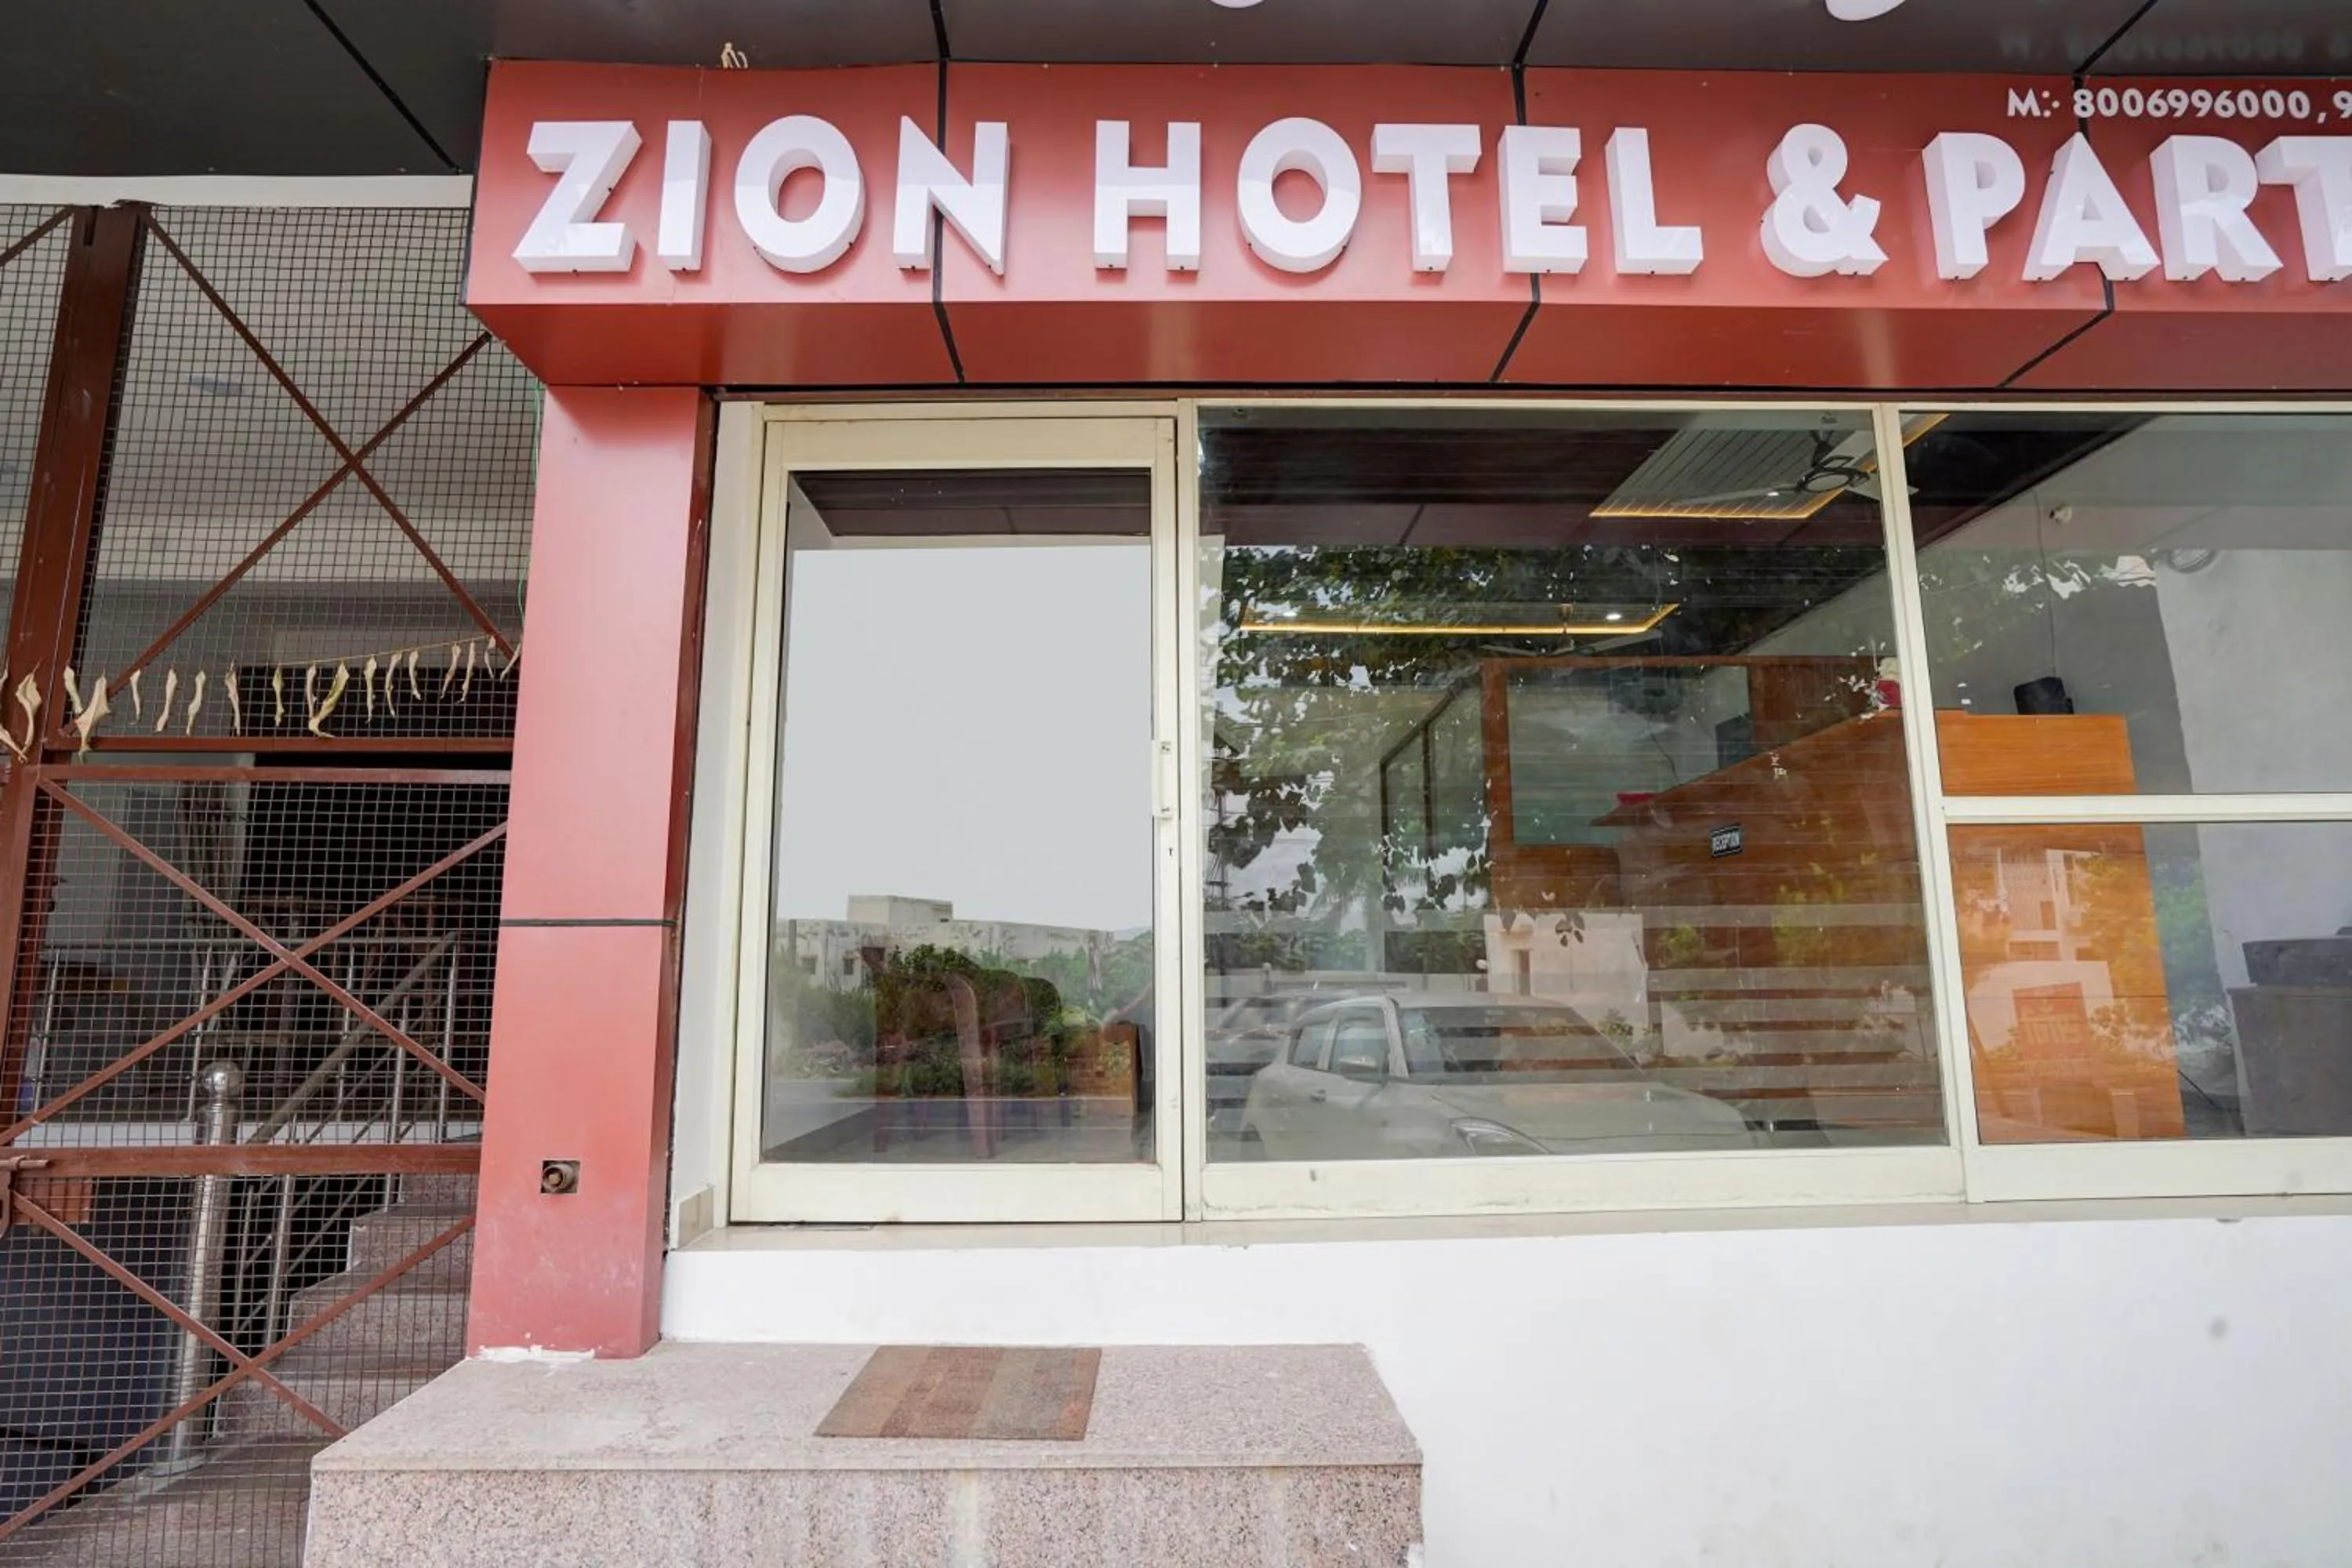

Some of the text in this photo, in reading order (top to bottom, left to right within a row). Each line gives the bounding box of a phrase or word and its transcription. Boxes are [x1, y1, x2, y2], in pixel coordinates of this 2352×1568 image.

[512, 114, 2352, 282] ZION HOTEL & PART
